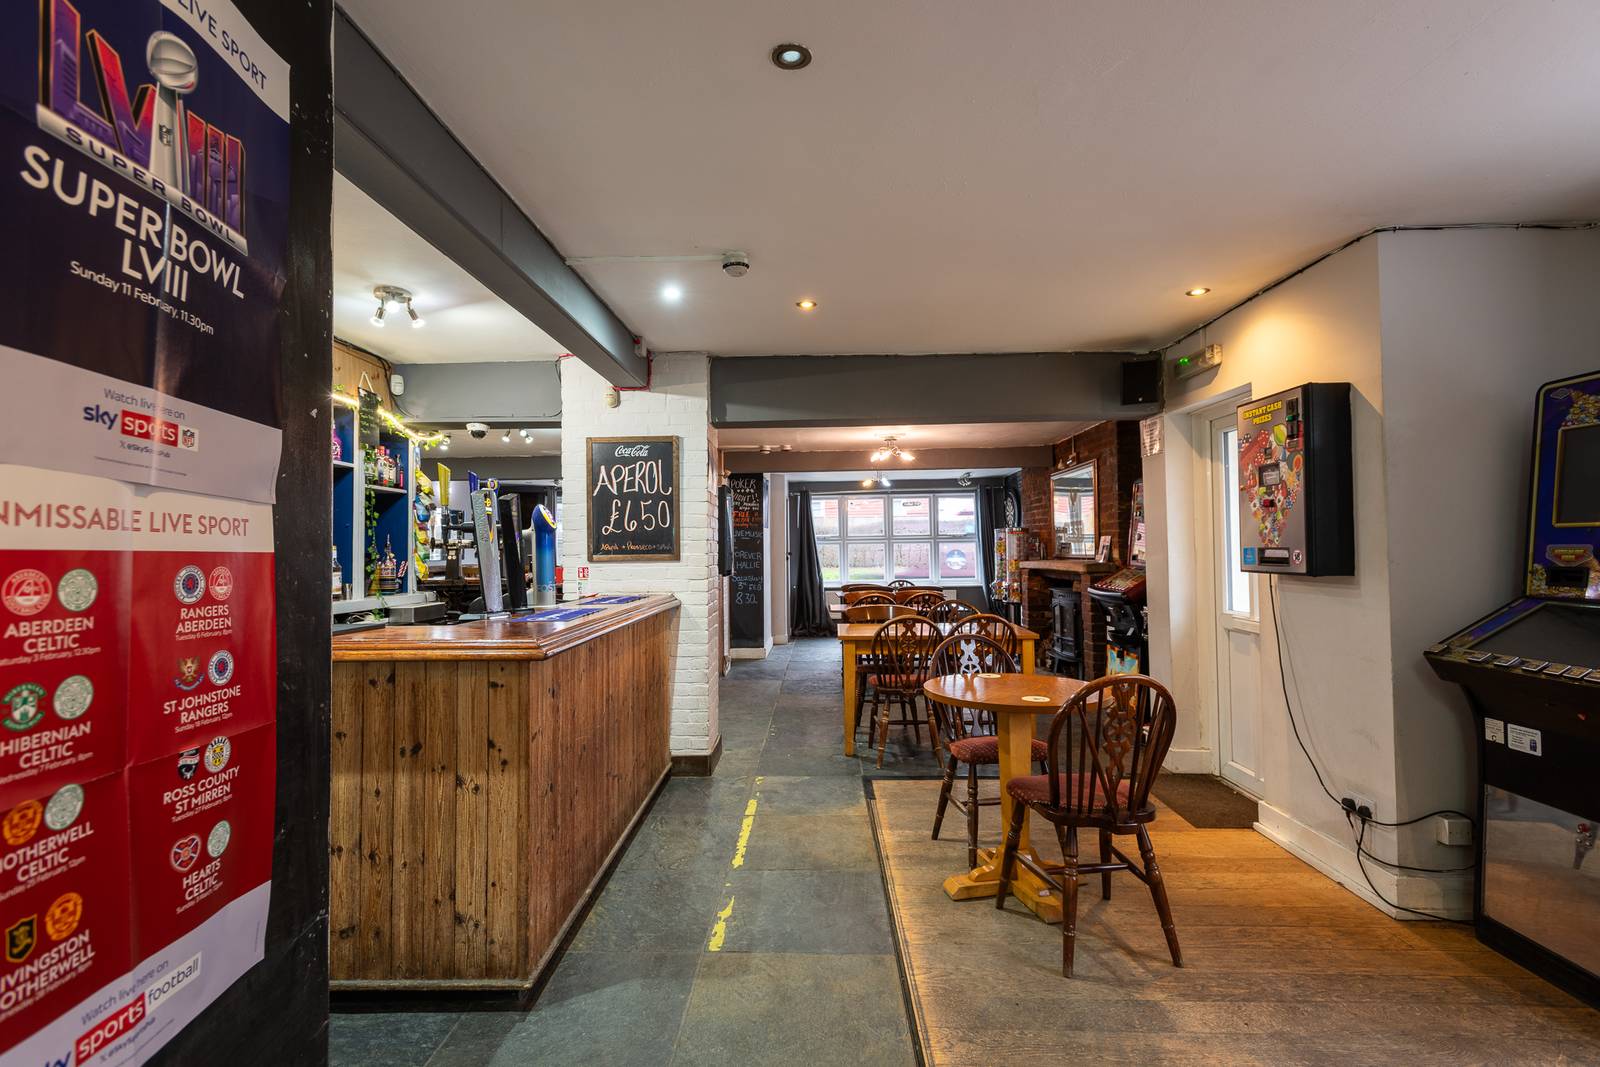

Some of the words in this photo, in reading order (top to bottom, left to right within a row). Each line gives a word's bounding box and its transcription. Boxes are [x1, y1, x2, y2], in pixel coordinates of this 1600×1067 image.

[222, 30, 266, 90] SPORT
[65, 126, 167, 197] SUPER
[181, 195, 237, 245] BOWL
[20, 145, 163, 248] SUPER
[170, 224, 244, 299] BOWL
[122, 239, 188, 302] LVIII
[70, 260, 120, 293] Sunday
[122, 283, 132, 296] 11
[134, 287, 179, 319] February,
[181, 310, 214, 336] 11.30pm
[104, 388, 138, 406] Watch
[174, 411, 185, 420] on
[1242, 406, 1267, 419] INSTANT
[1267, 401, 1282, 412] CASH
[83, 404, 118, 430] sky
[124, 416, 176, 441] spots
[593, 459, 672, 496] APEROL
[731, 479, 757, 490] POKER
[0, 500, 142, 532] NMISSABLE
[150, 511, 192, 534] LIVE
[198, 514, 249, 537] SPORT
[734, 550, 762, 560] OREVER
[736, 561, 760, 570] HALLIE
[3, 616, 95, 639] ABERDEEN
[176, 616, 232, 634] ABERDEEN
[180, 604, 229, 620] RANGERS
[22, 633, 80, 654] CELTIC
[163, 700, 178, 715] ST
[178, 685, 241, 711] JOHNSTONE
[180, 701, 229, 724] RANGERS
[0, 720, 91, 757] HIBERNIAN
[175, 723, 195, 734] Sunday
[19, 741, 74, 769] CELTIC
[163, 783, 196, 805] ROSS
[197, 765, 240, 792] COUNTY
[175, 798, 190, 815] ST
[191, 782, 231, 809] MIRREN
[16, 847, 70, 882] CELTIC
[182, 858, 221, 889] HEARTS
[185, 872, 218, 901] CELTIC
[0, 928, 90, 993] IVINGSTON
[0, 944, 96, 1010] OTHERWELL
[77, 999, 144, 1060] sports
[148, 958, 199, 1005] football
[81, 995, 116, 1025] Watch
[118, 984, 136, 1001] live
[135, 969, 155, 989] here
[156, 960, 169, 973] on
